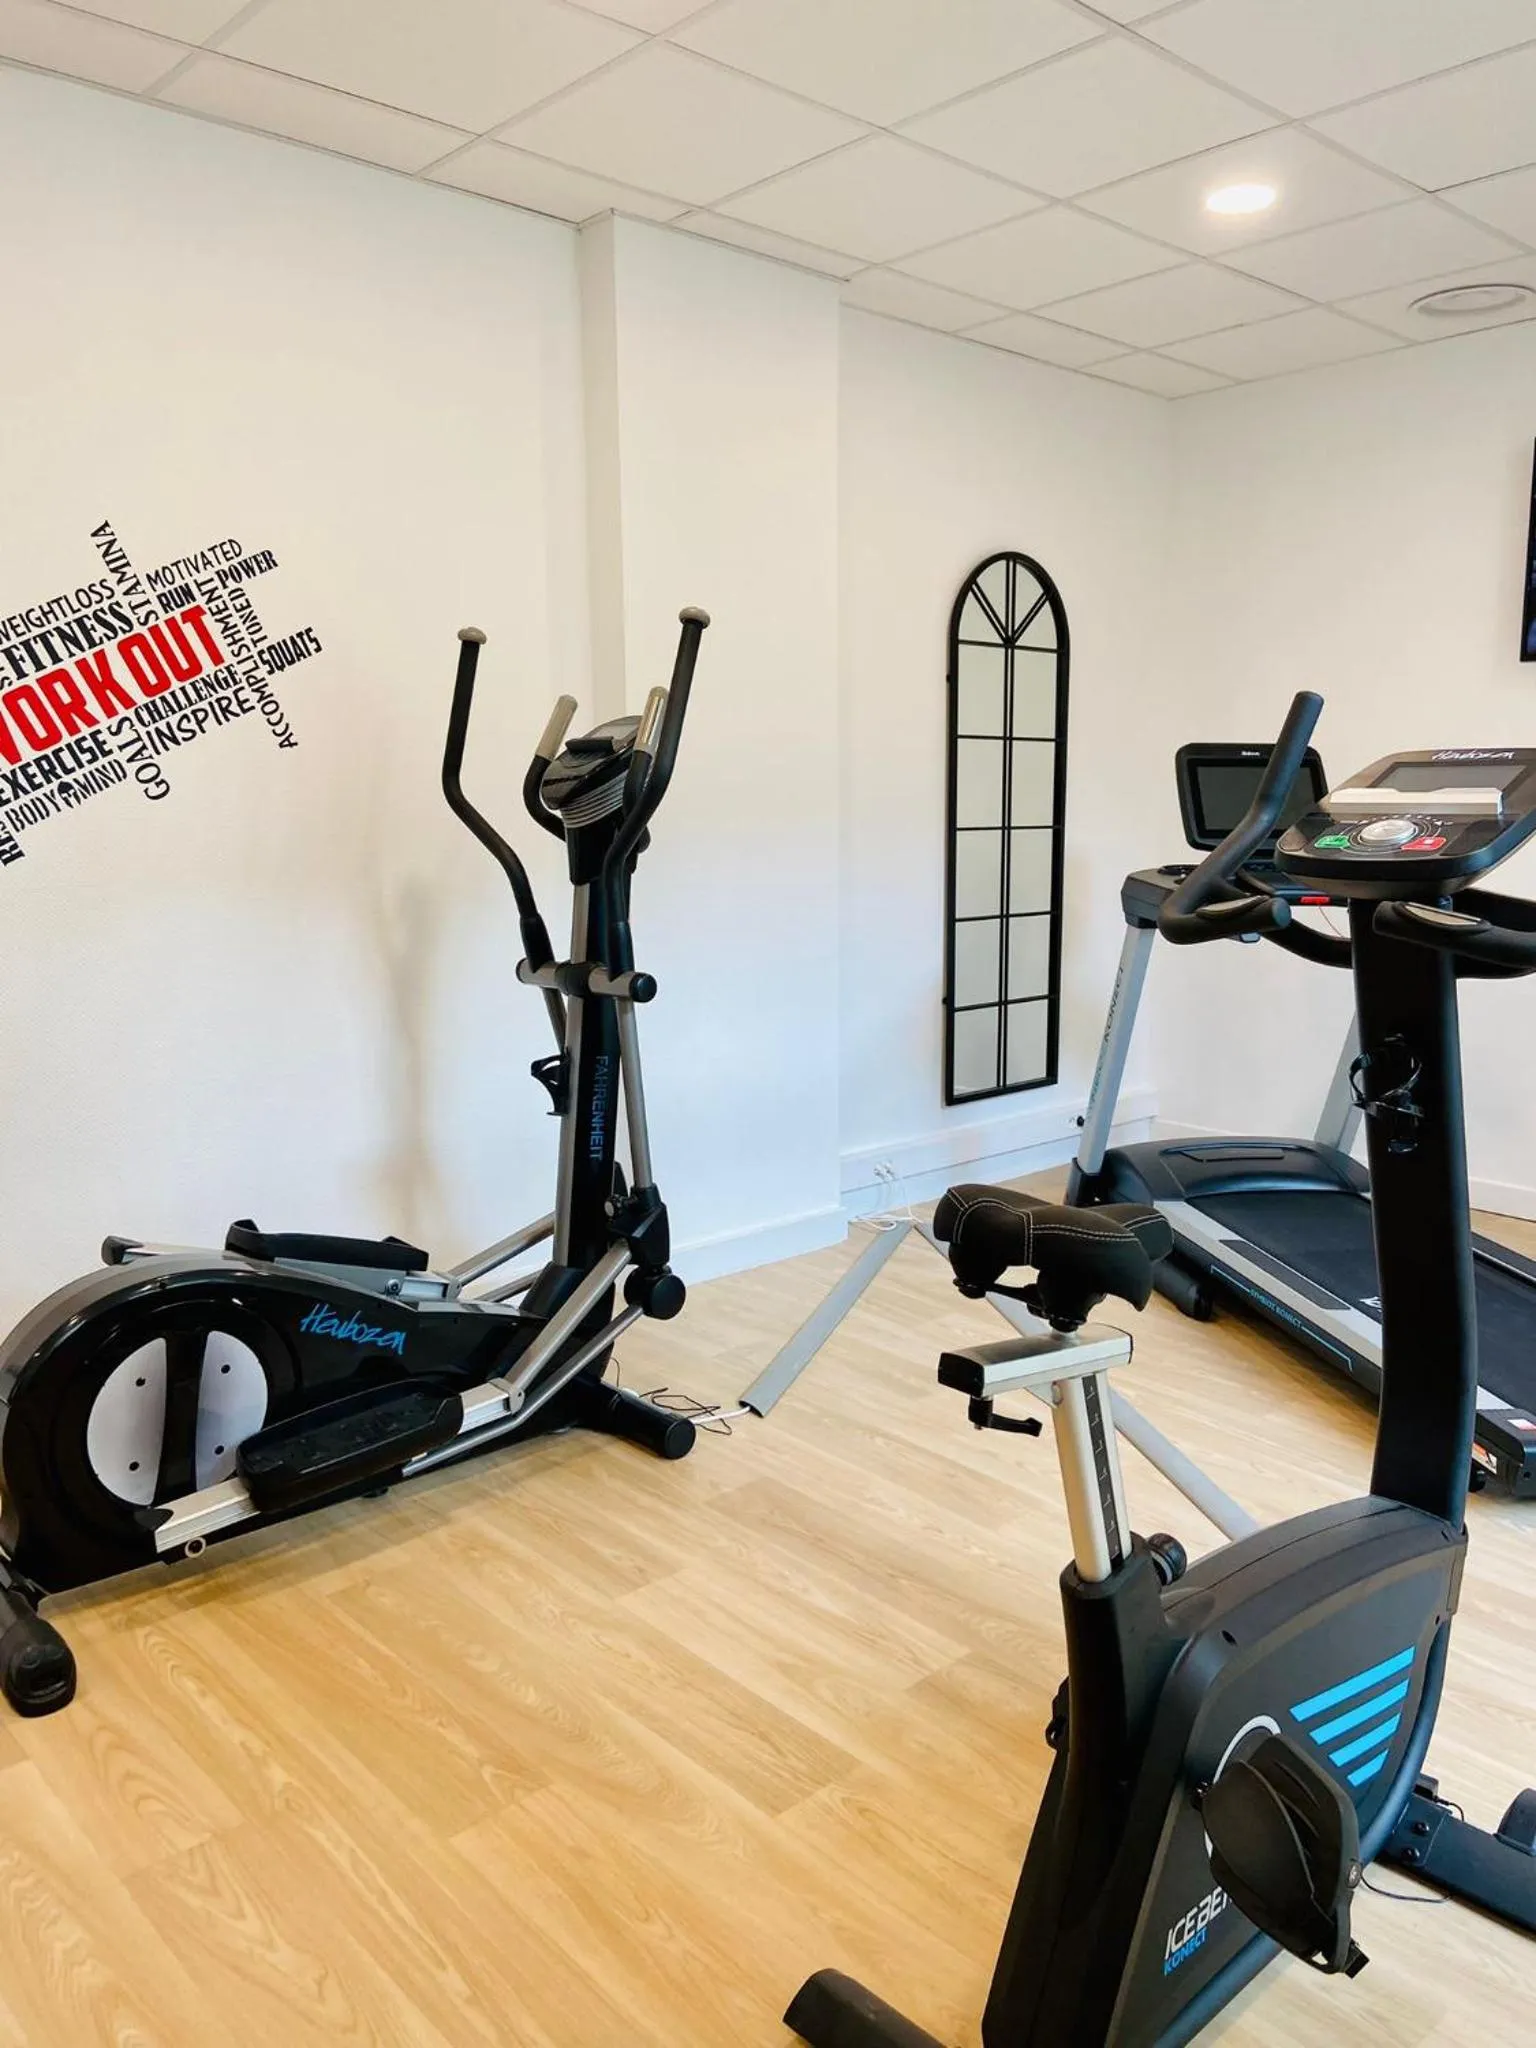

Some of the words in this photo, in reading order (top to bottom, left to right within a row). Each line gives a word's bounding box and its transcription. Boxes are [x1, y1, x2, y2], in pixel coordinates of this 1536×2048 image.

[91, 520, 159, 626] STAMINA
[146, 539, 243, 592] MOTIVATED
[156, 583, 197, 614] RUN
[215, 550, 278, 589] POWER
[0, 600, 134, 681] FITNESS
[227, 587, 268, 648] TONED
[257, 627, 323, 676] SQUATS
[134, 664, 243, 728] CHALLENGE
[194, 578, 299, 749] ACCOMPLISHMENT
[146, 686, 256, 756] INSPIRE
[106, 716, 170, 800] GOALS
[5, 789, 62, 832] BODY
[73, 759, 127, 800] MIND
[590, 1055, 609, 1160] FAHRENHEIT
